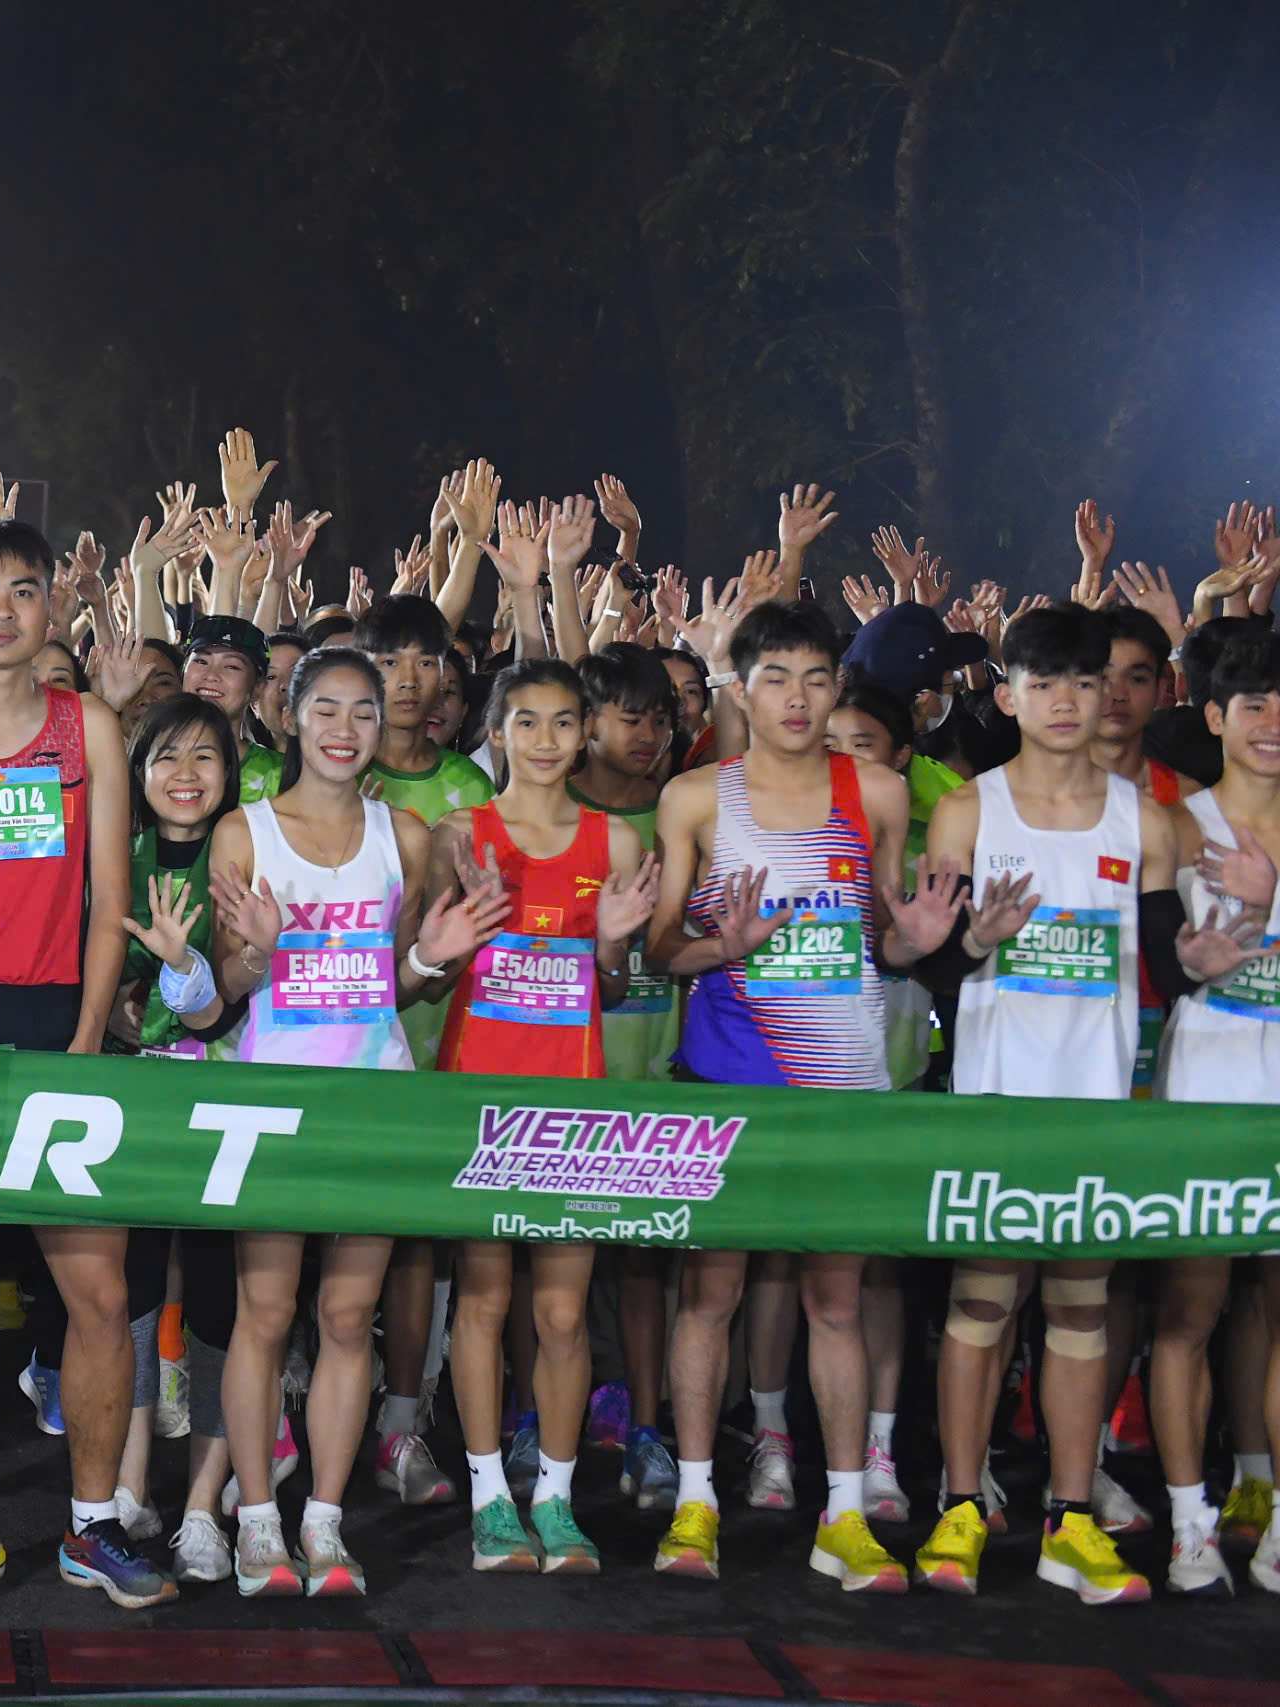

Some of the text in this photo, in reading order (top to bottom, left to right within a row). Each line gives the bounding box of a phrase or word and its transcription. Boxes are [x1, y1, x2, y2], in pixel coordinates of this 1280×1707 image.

[989, 854, 1025, 869] Elite
[280, 900, 384, 933] XRC
[770, 926, 844, 954] 51202
[1016, 923, 1106, 954] E50012
[288, 953, 379, 981] E54004
[491, 951, 579, 983] E54006
[481, 1107, 743, 1157] VIETNAM
[470, 1150, 723, 1181] INTERNATIONAL
[457, 1171, 719, 1197] HALF MARATHON 2025
[565, 1200, 606, 1212] POWERED
